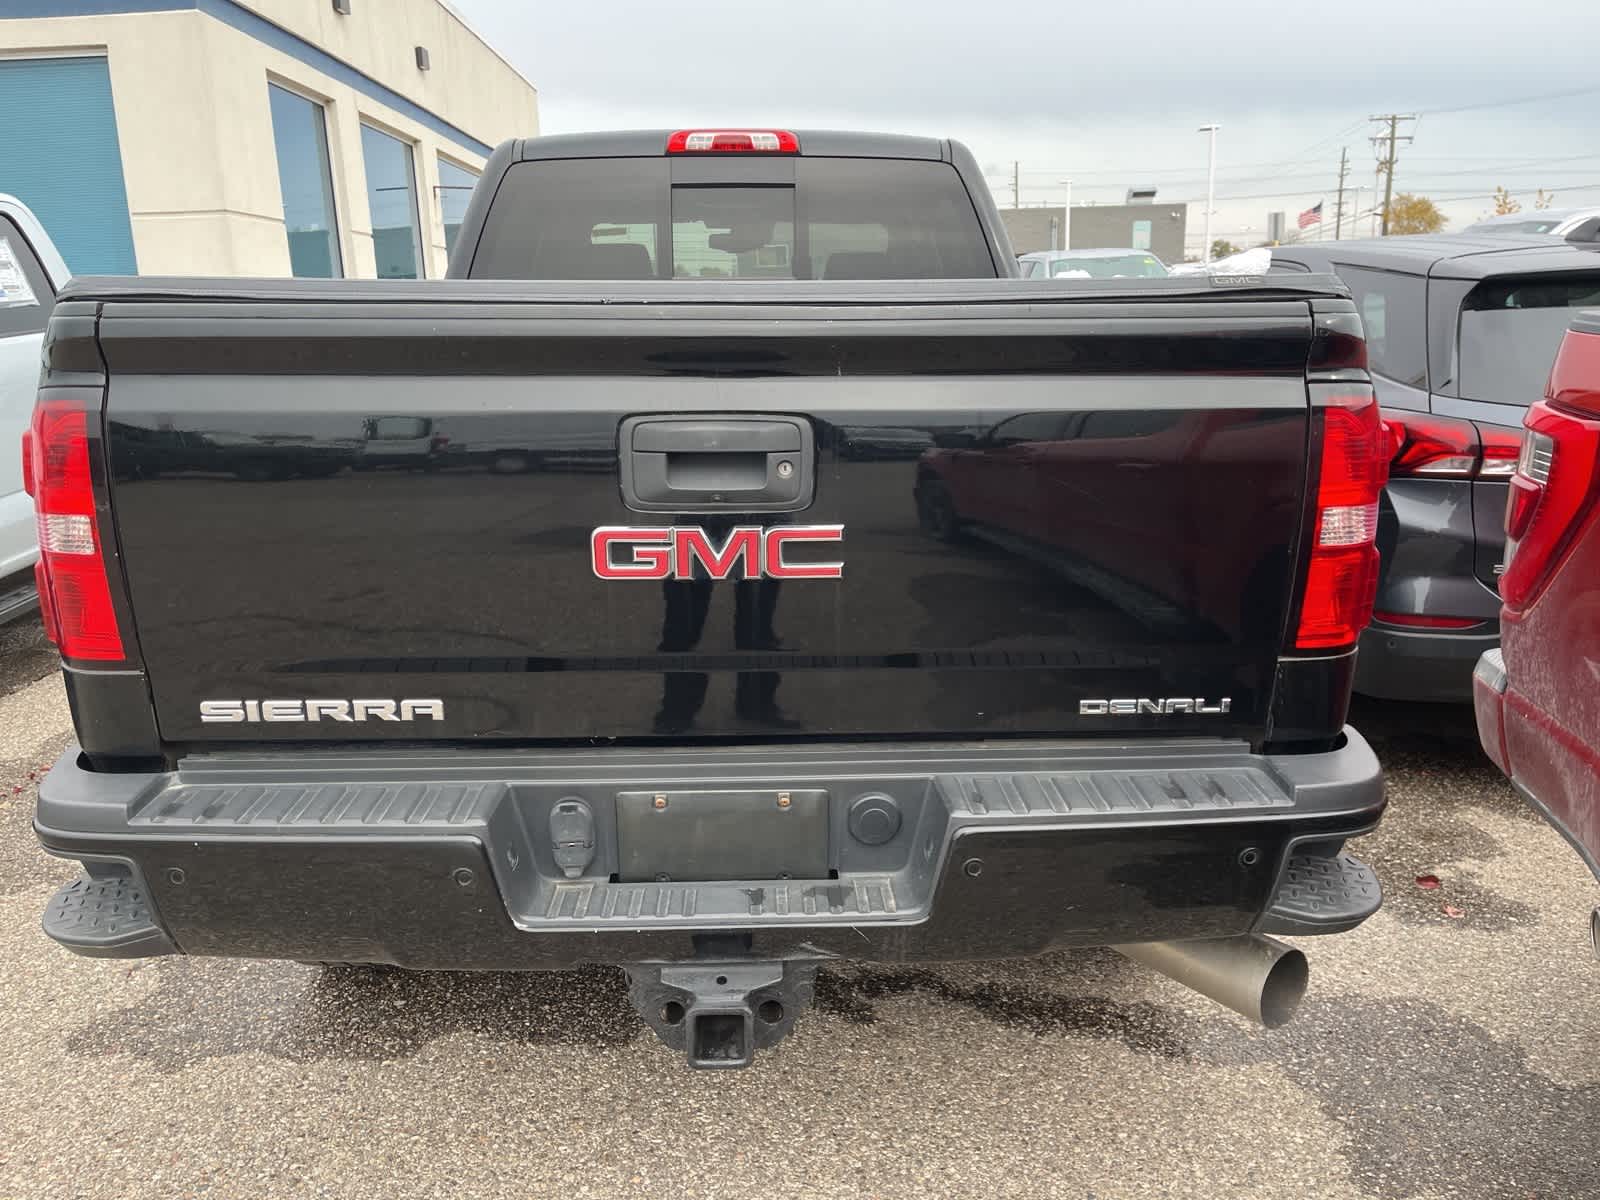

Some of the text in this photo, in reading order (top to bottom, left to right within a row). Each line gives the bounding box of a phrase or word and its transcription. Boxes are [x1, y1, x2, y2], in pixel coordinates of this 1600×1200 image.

[1213, 276, 1262, 285] GMC
[591, 524, 845, 580] GMC
[200, 699, 445, 722] SIERRA
[1079, 698, 1232, 715] DENALI
